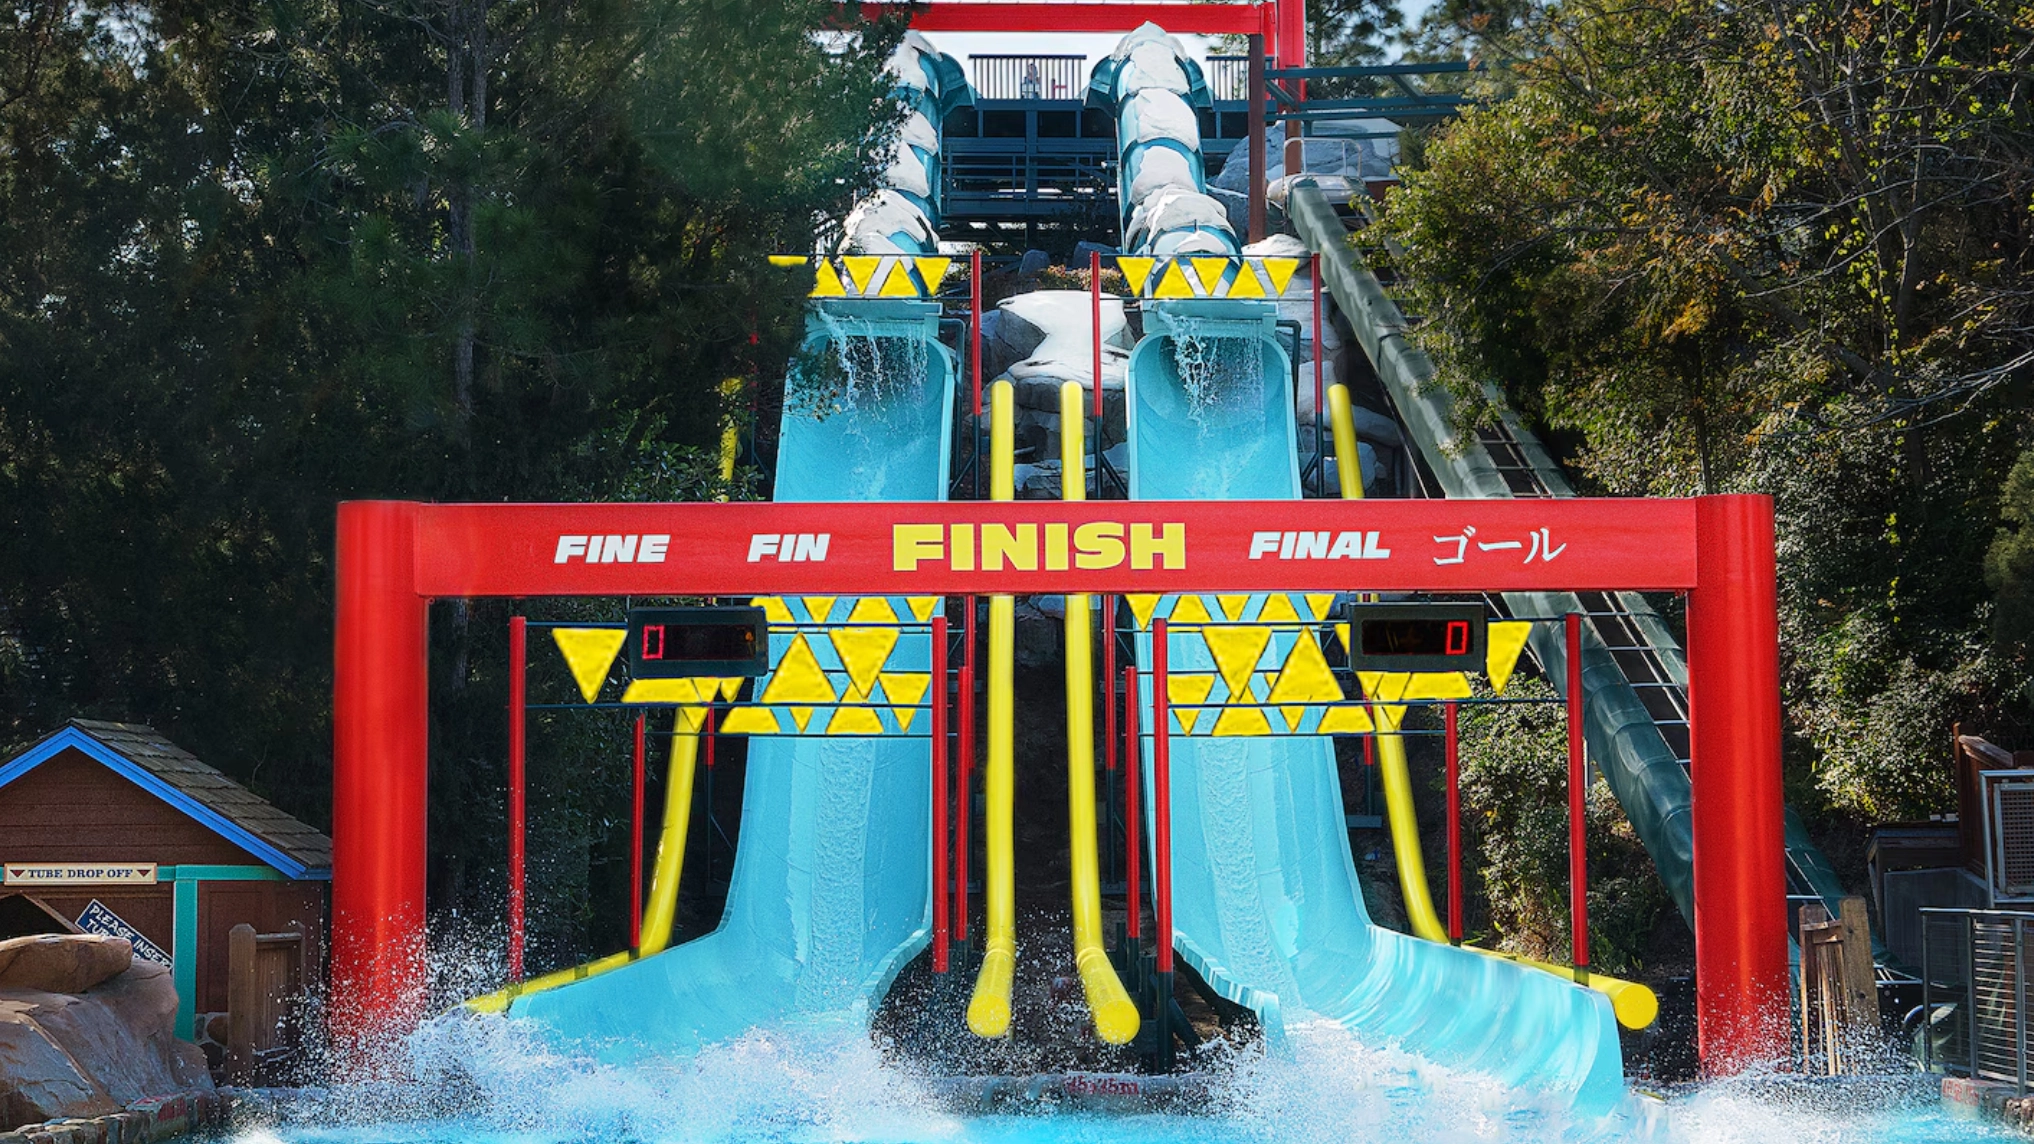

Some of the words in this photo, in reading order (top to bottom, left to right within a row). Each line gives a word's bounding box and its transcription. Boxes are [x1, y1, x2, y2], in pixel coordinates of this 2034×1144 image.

[554, 534, 671, 564] FINE
[746, 533, 831, 563] FIN
[892, 522, 1186, 571] FINISH
[1248, 531, 1391, 560] FINAL
[1432, 525, 1568, 566] ゴール
[28, 869, 63, 878] TUBE
[67, 869, 104, 878] DROP
[107, 869, 133, 878] OFF
[86, 918, 113, 937] TUB
[88, 904, 135, 941] PLEASE
